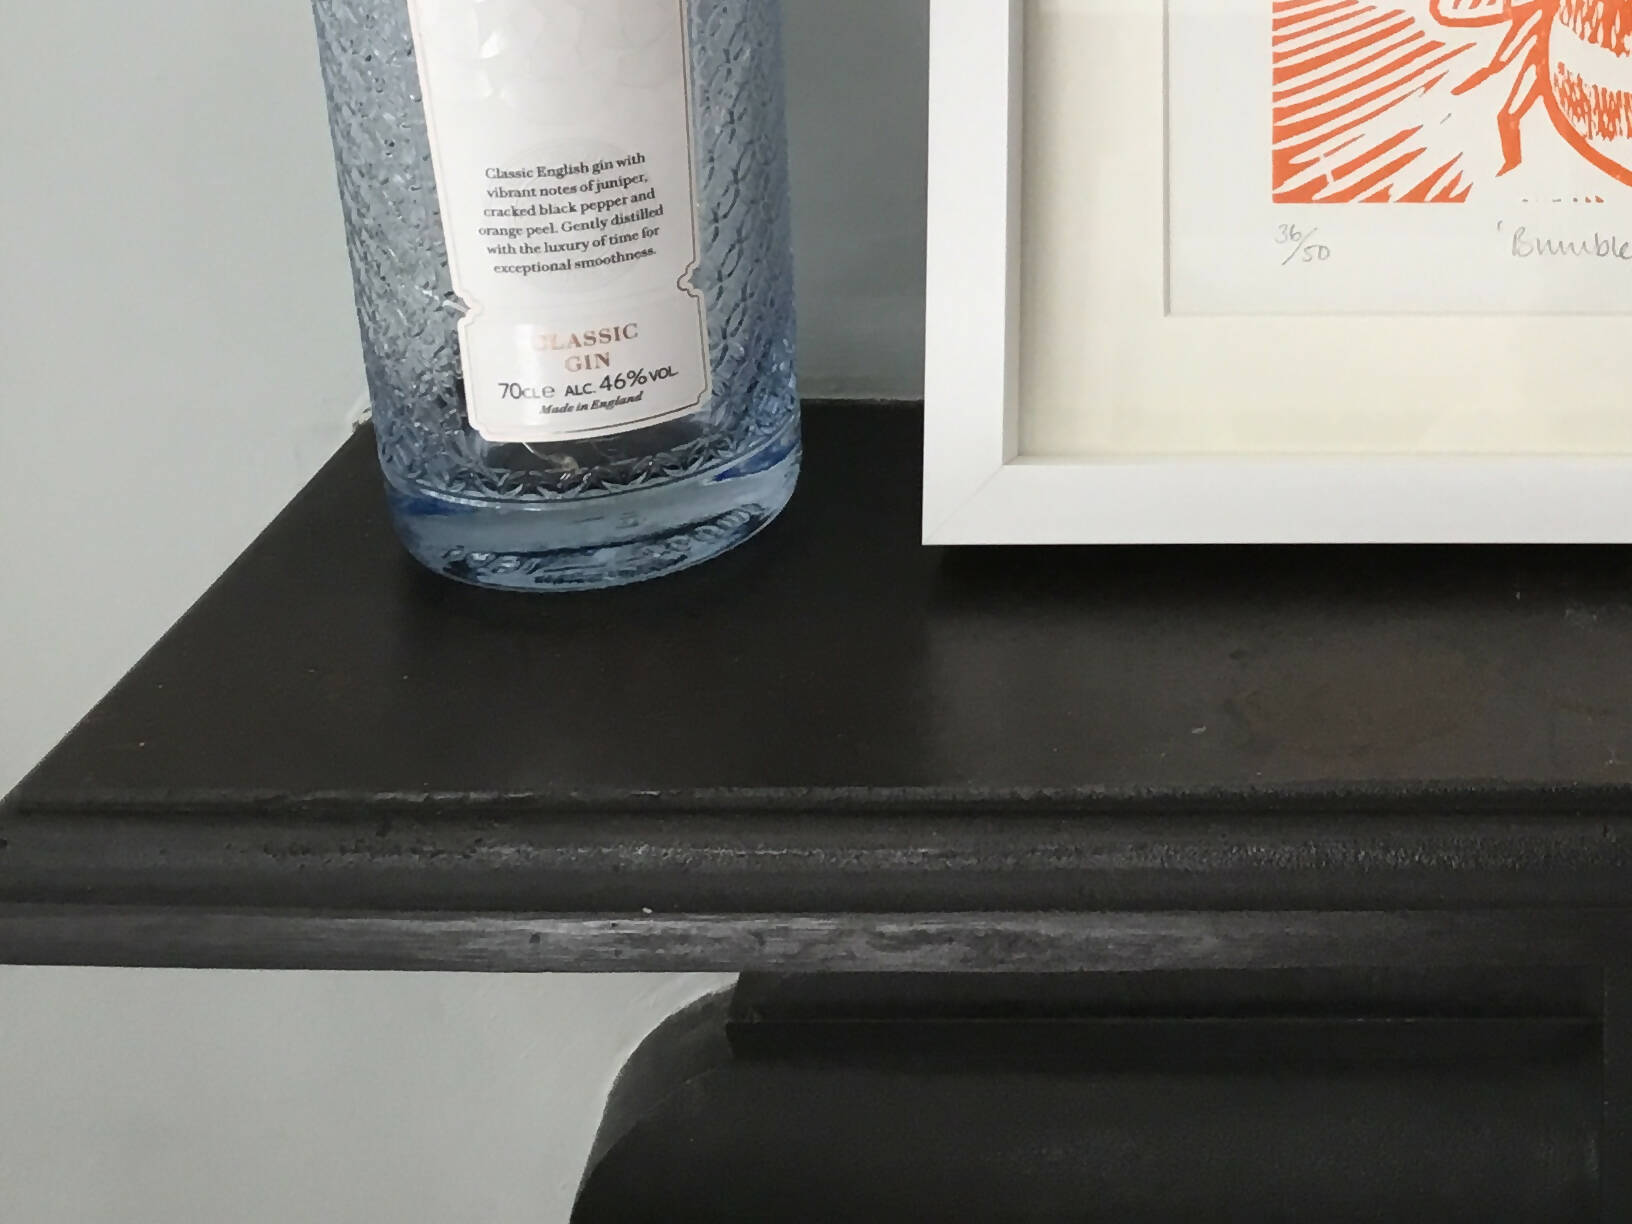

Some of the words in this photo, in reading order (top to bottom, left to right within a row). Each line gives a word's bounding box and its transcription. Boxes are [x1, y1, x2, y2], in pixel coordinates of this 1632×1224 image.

[484, 167, 533, 179] Classic
[536, 161, 589, 179] English
[592, 159, 613, 174] gin
[616, 152, 645, 168] with
[486, 186, 536, 198] vibrant
[539, 184, 577, 197] notes
[579, 180, 596, 192] of
[595, 172, 649, 194] juniper,
[483, 204, 536, 217] cracked
[539, 202, 577, 216] black
[580, 196, 628, 215] pepper
[630, 187, 656, 203] and
[478, 227, 523, 239] orange
[526, 223, 559, 238] peel.
[561, 217, 609, 233] Gently
[610, 204, 664, 226] distilled
[487, 243, 517, 254] with
[519, 243, 541, 254] the
[544, 239, 590, 254] luxury
[592, 234, 609, 247] of
[608, 232, 639, 246] time
[641, 226, 660, 239] for
[493, 259, 571, 276] exceptional
[574, 245, 657, 269] smoothness.
[531, 323, 639, 351] CLASSIC
[564, 352, 611, 372] GIN
[599, 368, 648, 392] 46%
[649, 365, 680, 382] VOL
[538, 403, 573, 415] Made
[575, 400, 589, 412] in
[590, 391, 644, 410] England
